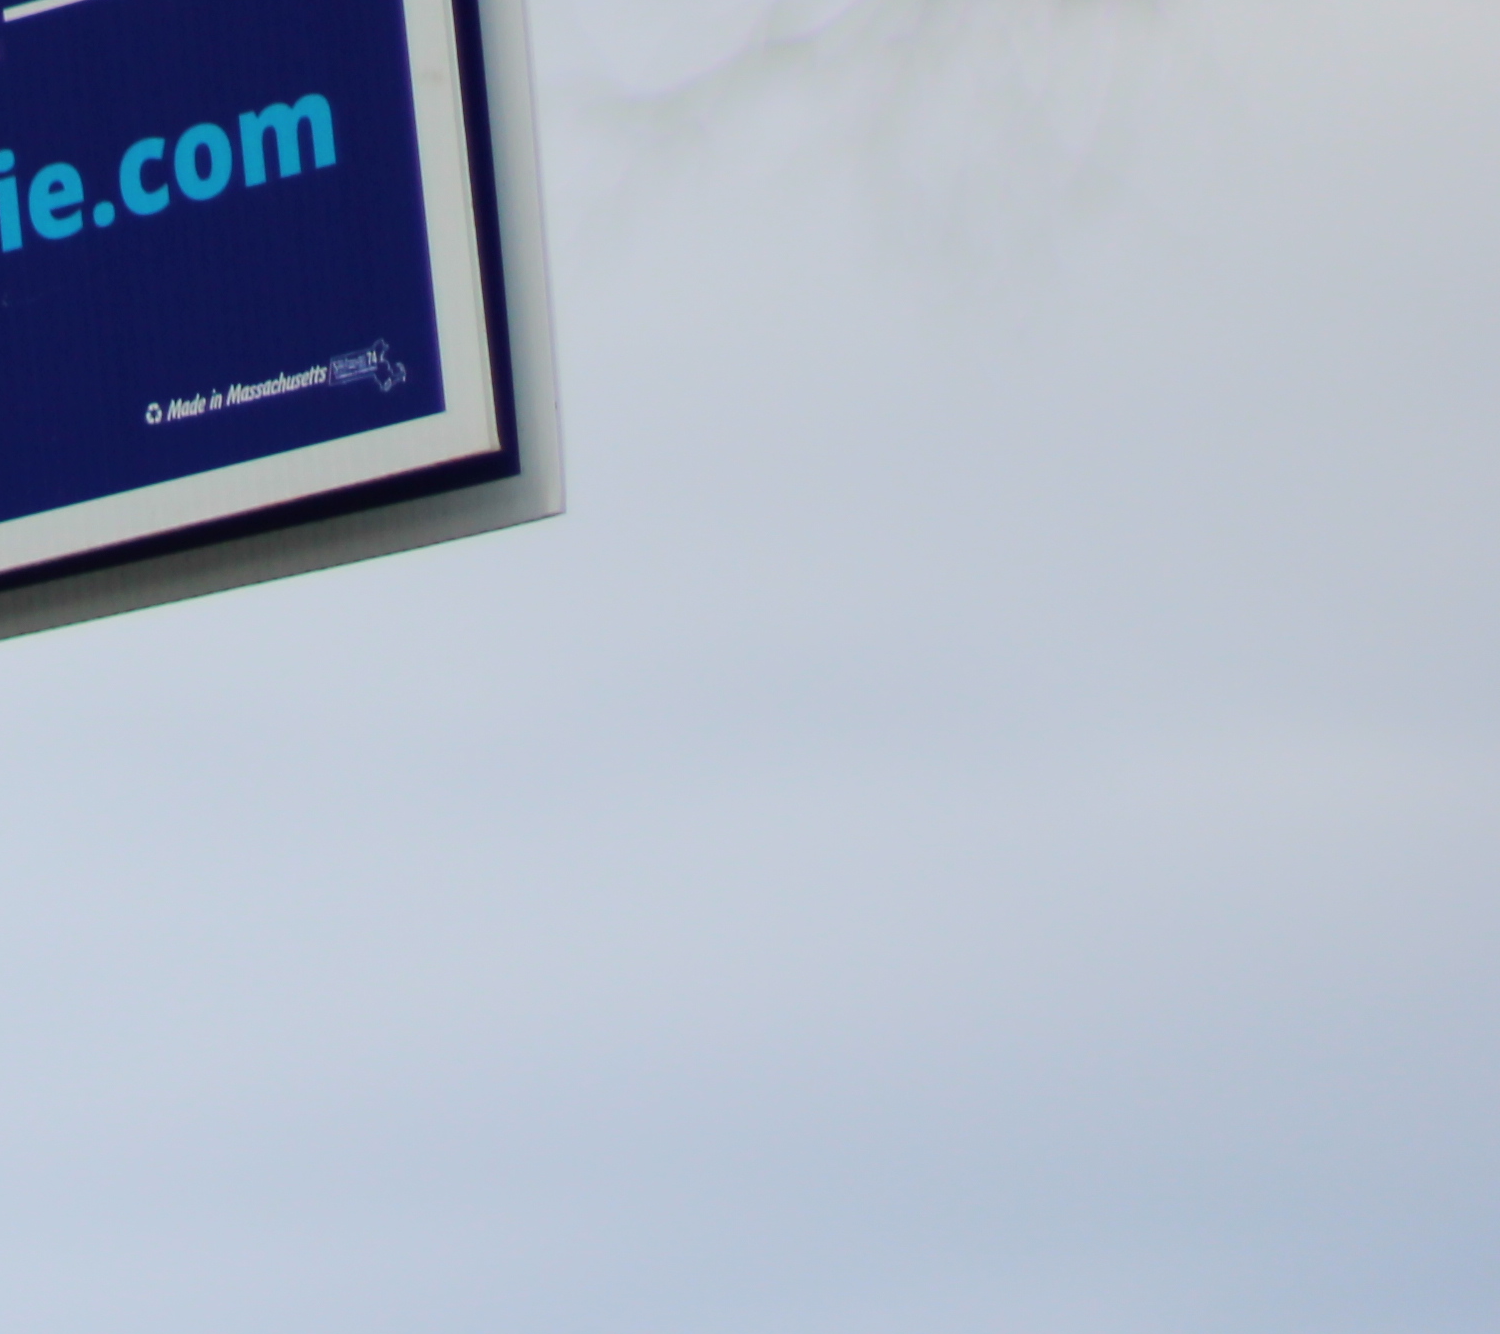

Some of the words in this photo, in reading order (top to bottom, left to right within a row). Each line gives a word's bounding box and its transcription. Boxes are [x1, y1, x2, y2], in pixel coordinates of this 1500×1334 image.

[167, 392, 206, 421] Made
[210, 387, 223, 410] in
[226, 364, 328, 406] Massachusetts
